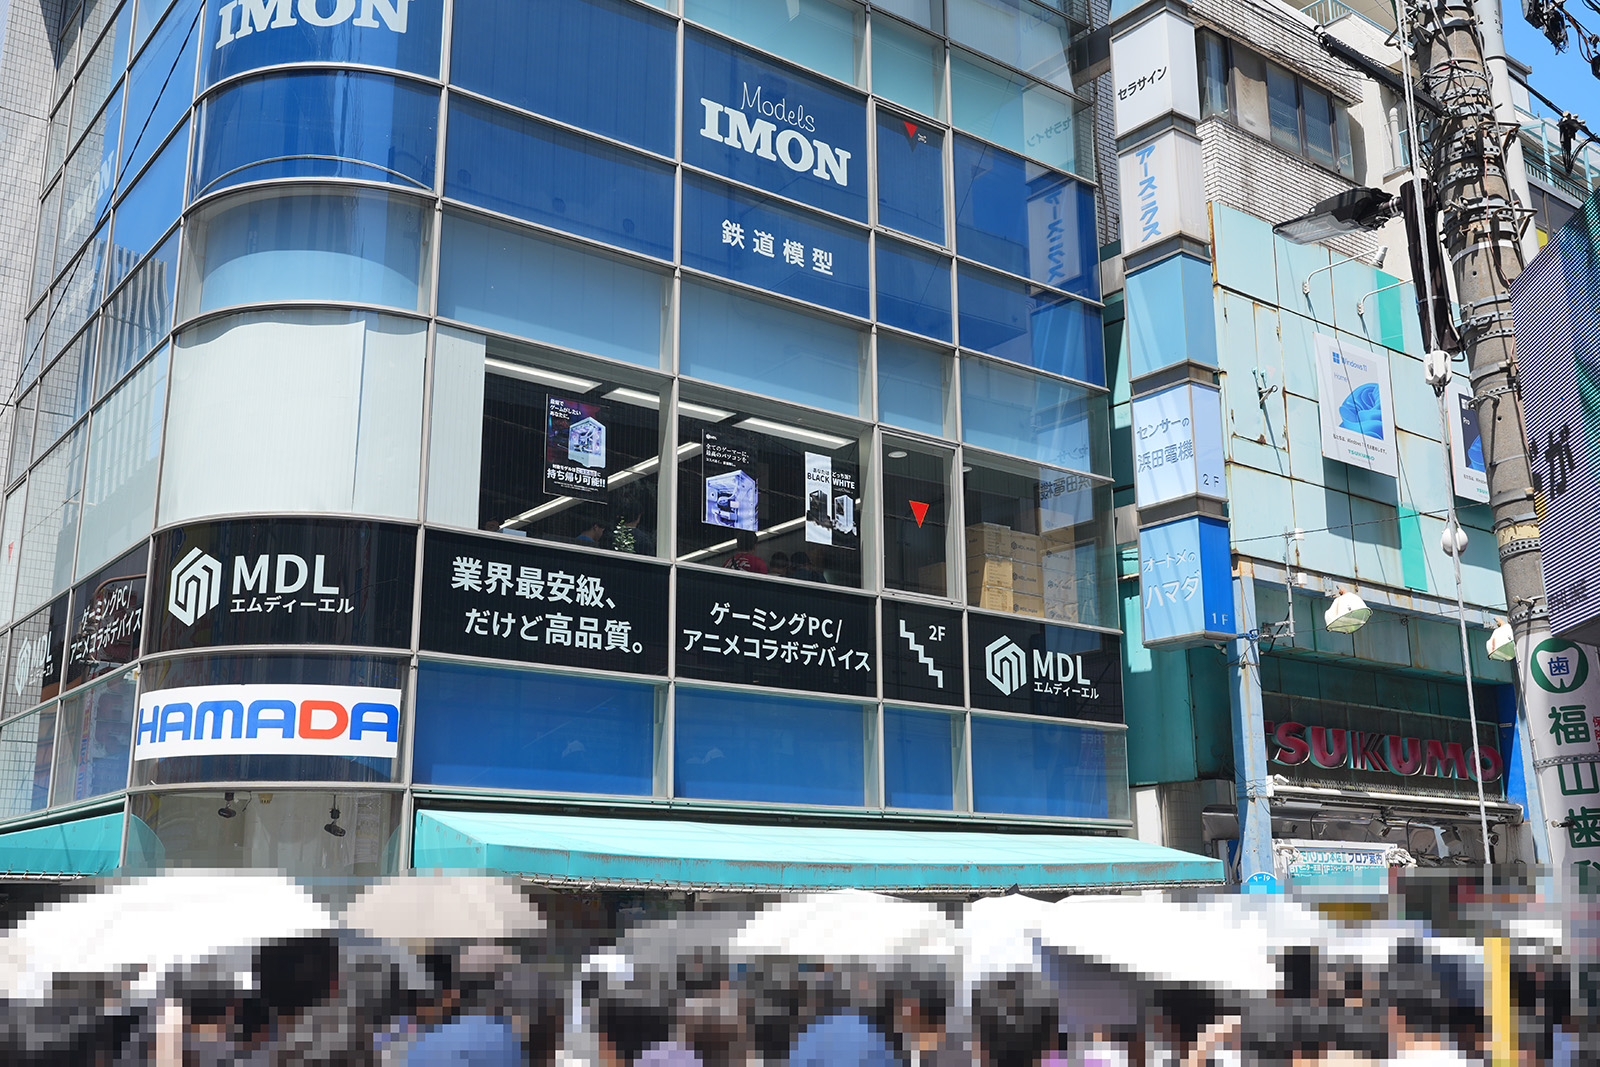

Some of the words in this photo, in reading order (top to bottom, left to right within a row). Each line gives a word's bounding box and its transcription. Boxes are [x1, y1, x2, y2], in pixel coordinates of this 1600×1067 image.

[1118, 66, 1167, 101] セラサイン
[741, 82, 816, 132] Models
[700, 98, 851, 186] IMON
[722, 219, 833, 275] 鉄道模型
[1137, 417, 1190, 441] センサーの
[1137, 439, 1194, 473] 浜田電機
[1348, 449, 1375, 461] TSUKUMO
[807, 472, 829, 484] BLACK
[832, 478, 855, 490] WHITE
[232, 553, 339, 595] MDL
[1143, 549, 1196, 572] オートメの
[451, 555, 616, 609] 業界最安級、
[1145, 570, 1201, 610] ハマダ
[230, 596, 354, 614] エムディーエル
[710, 602, 843, 643] ゲーミングPC/
[1212, 612, 1228, 625] 1F
[464, 608, 643, 655] だけど高品質。
[929, 625, 946, 642] 2F
[31, 631, 52, 669] MDL
[682, 627, 871, 673] アニメコラボデバイス
[1033, 649, 1091, 685] MDL
[1548, 656, 1570, 677] 歯
[1034, 681, 1099, 699] エムディーエル
[137, 699, 399, 745] HAMADA
